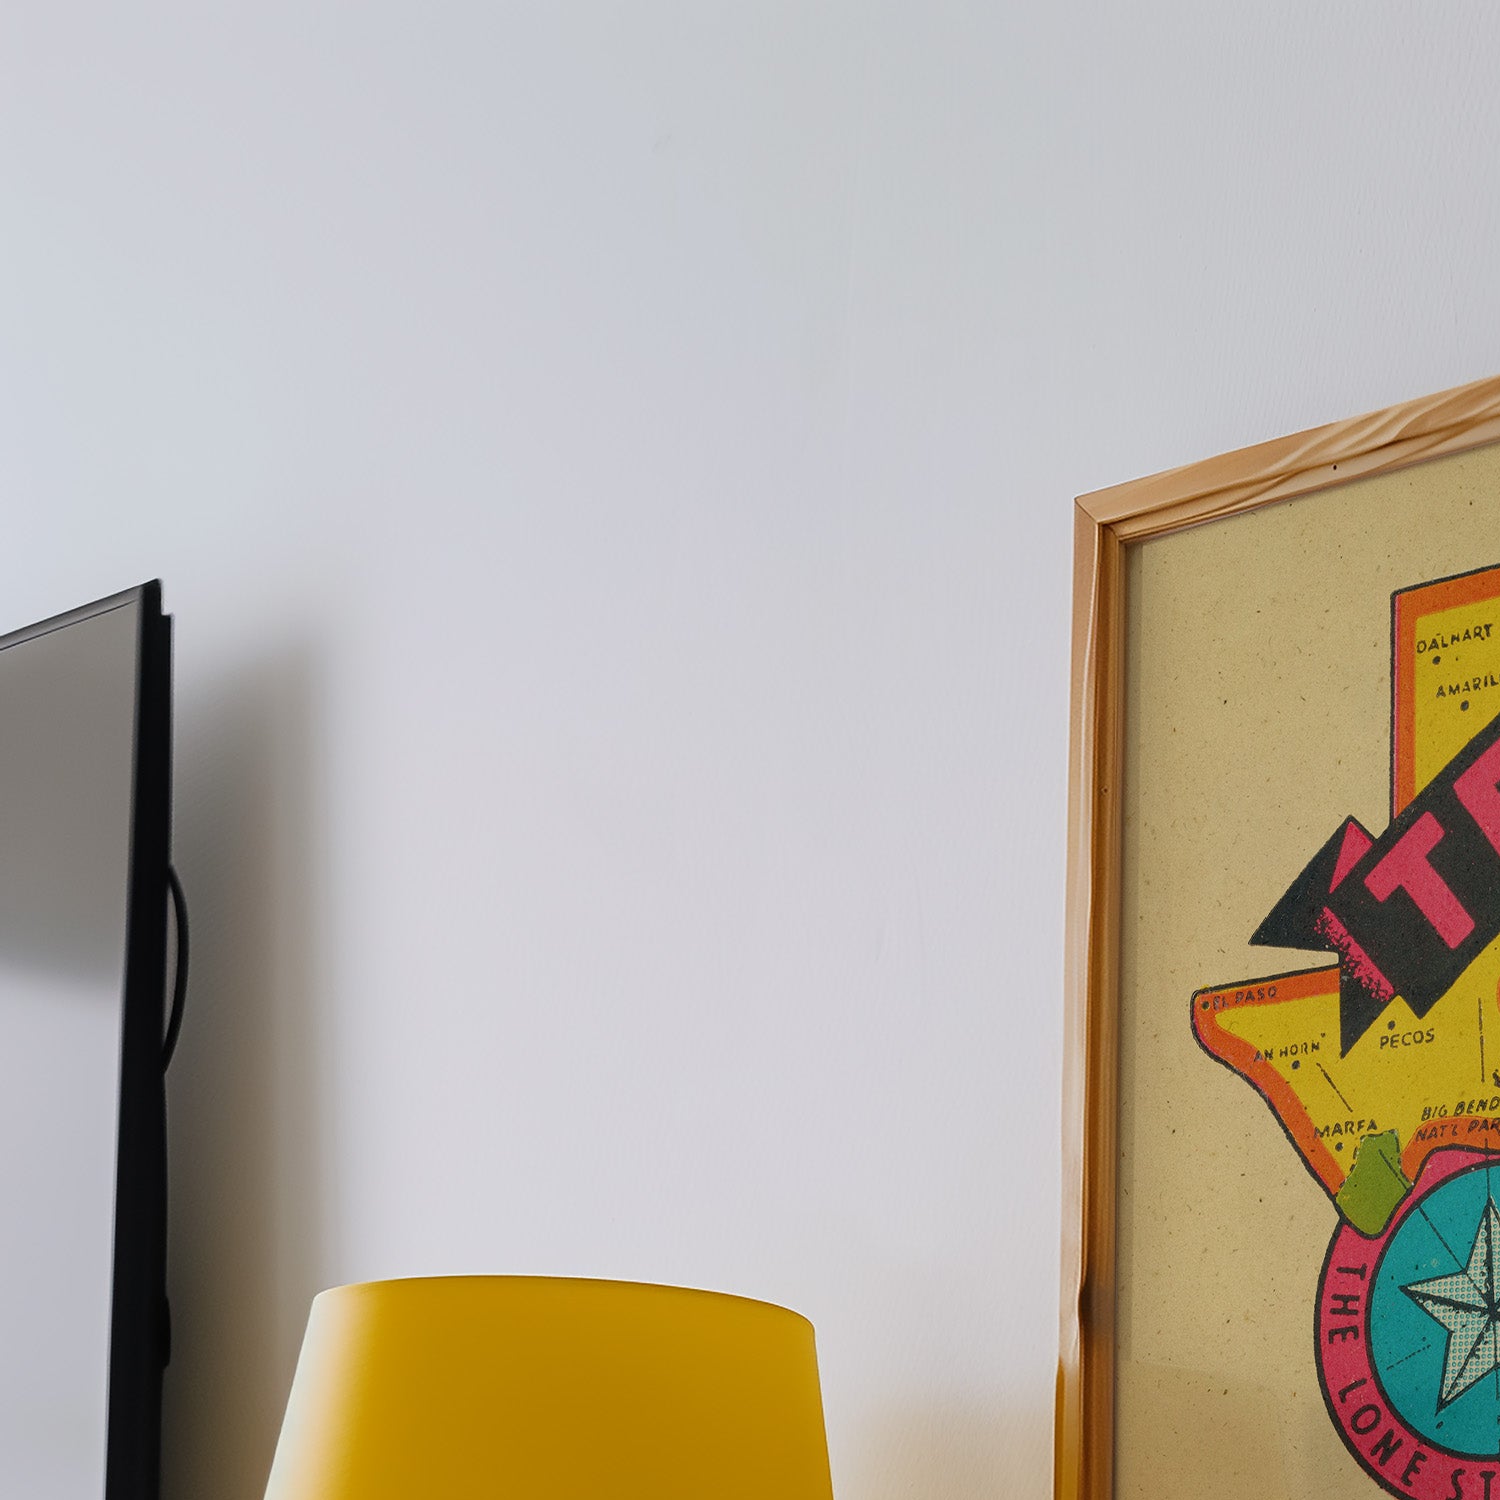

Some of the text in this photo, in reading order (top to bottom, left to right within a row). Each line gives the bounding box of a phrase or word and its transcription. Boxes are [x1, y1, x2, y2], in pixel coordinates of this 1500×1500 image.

[1416, 623, 1493, 653] DALHART
[1212, 985, 1278, 1011] EL PASO
[1279, 1040, 1320, 1058] HORN
[1379, 1028, 1436, 1049] PECOS
[1421, 1096, 1500, 1121] BIG BEND
[1313, 1118, 1378, 1140] MARFA
[1328, 1263, 1368, 1345] THE
[1338, 1377, 1428, 1487] LONE
